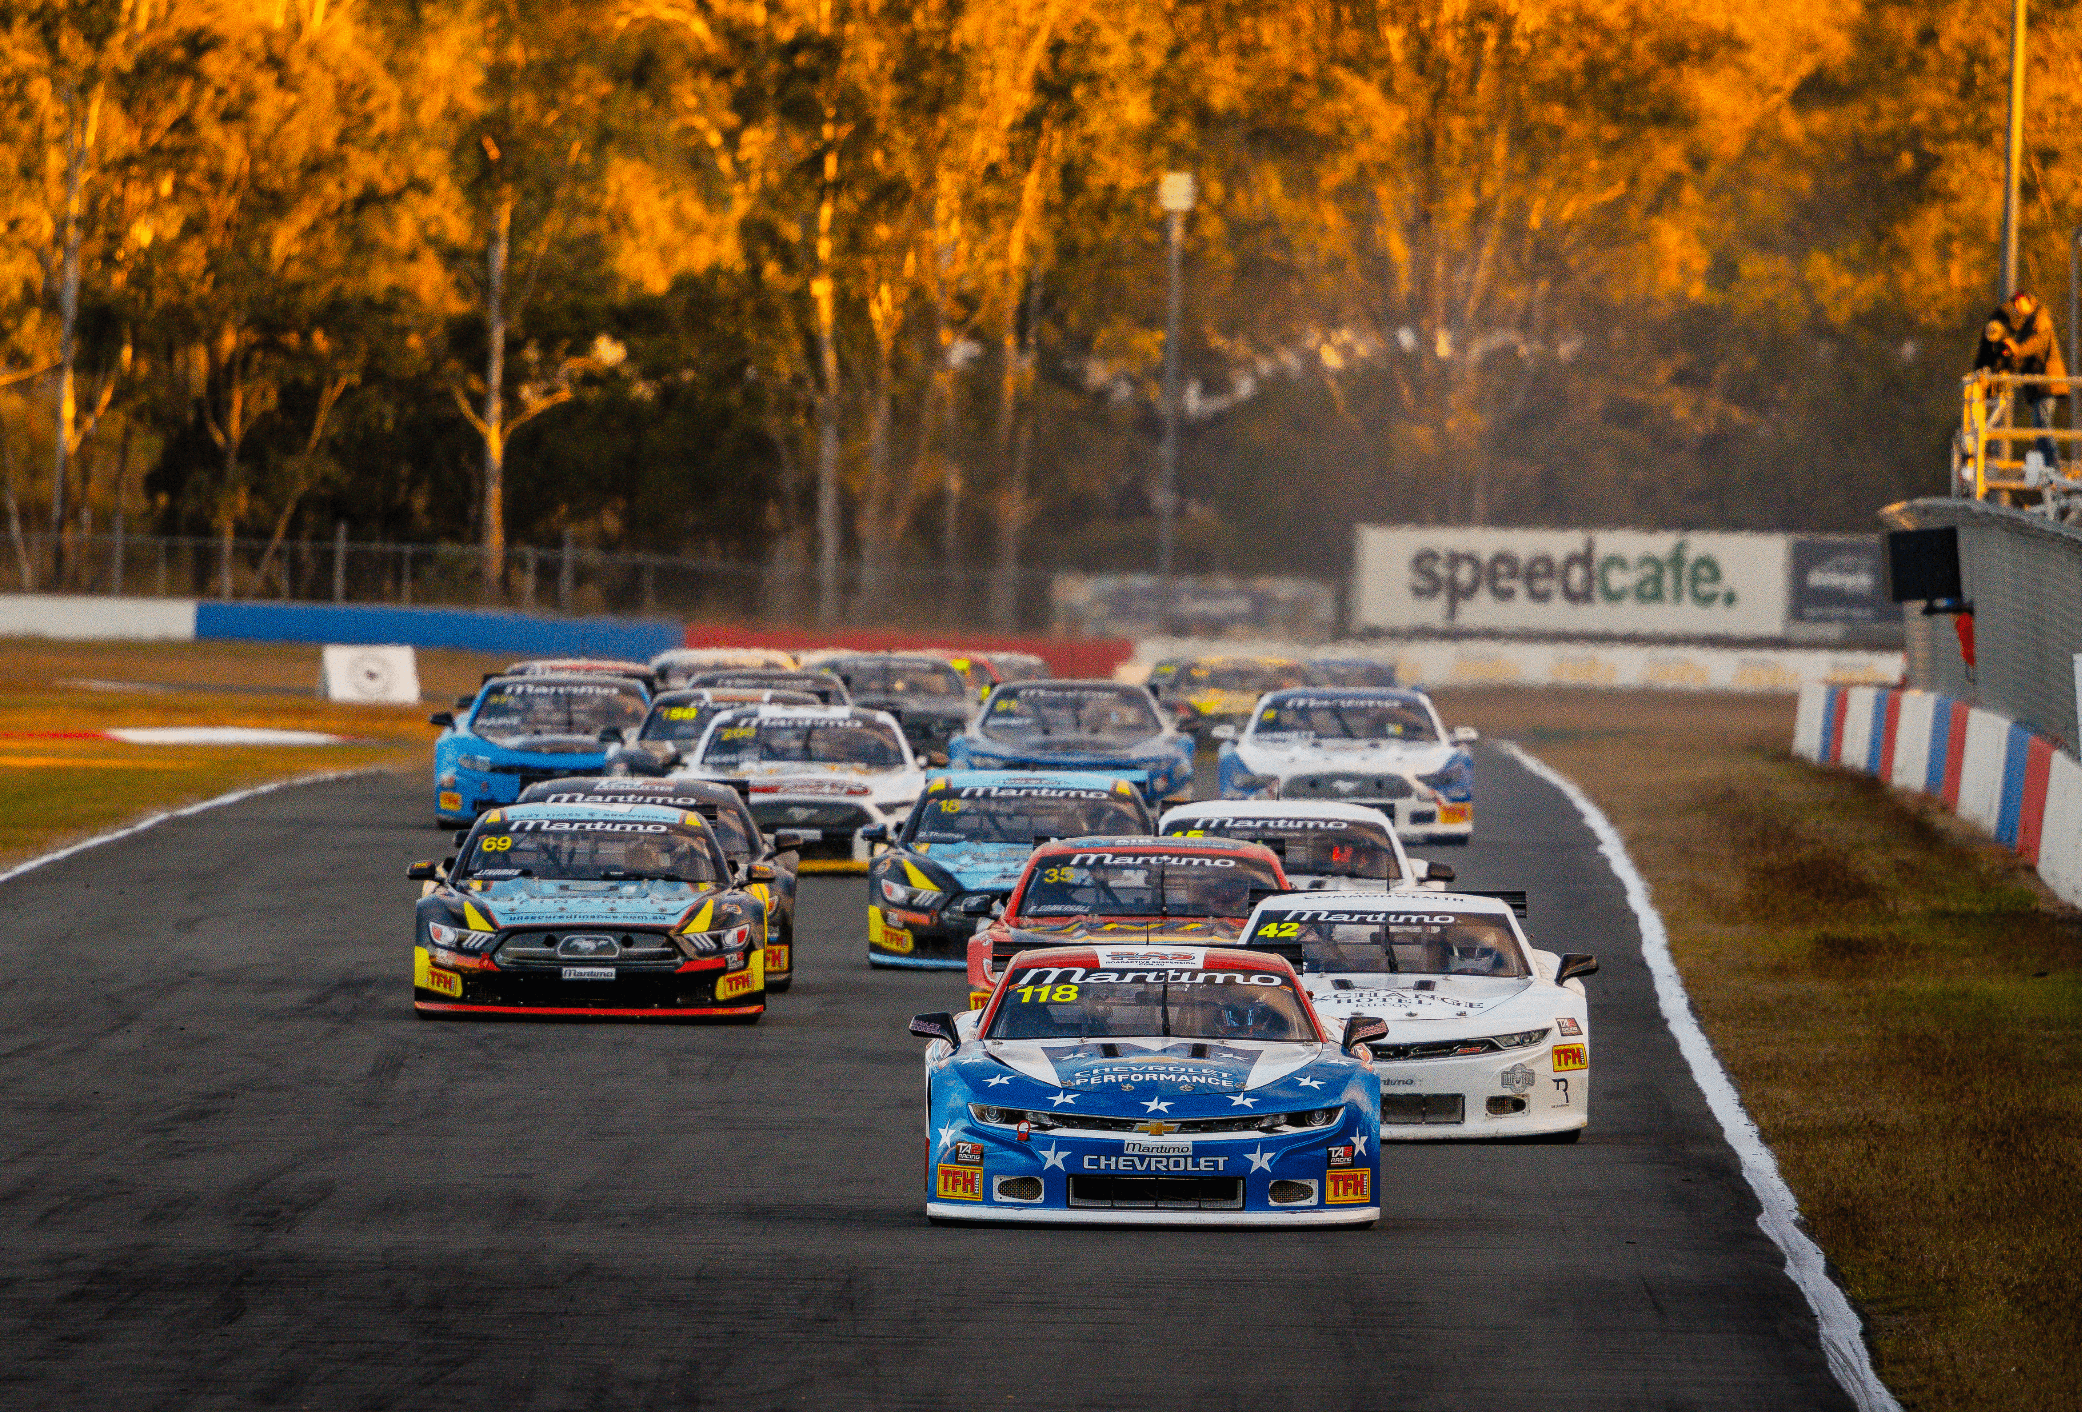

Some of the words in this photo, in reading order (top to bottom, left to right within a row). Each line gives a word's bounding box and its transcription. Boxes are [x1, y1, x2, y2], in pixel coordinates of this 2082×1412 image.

[1409, 537, 1737, 624] speedcafe.
[509, 819, 668, 833] Maritimo
[481, 836, 513, 852] 69
[1069, 853, 1236, 868] Maritimo
[1043, 867, 1075, 883] 35
[1283, 909, 1455, 924] Maritimo
[1257, 922, 1300, 938] 42
[727, 974, 749, 991] TFH
[1018, 967, 1282, 986] Maritimo
[1016, 985, 1079, 1003] 118
[1554, 1047, 1582, 1066] TFH
[1075, 1073, 1235, 1088] PERFORMANCE
[957, 1142, 982, 1155] TA2
[1125, 1141, 1190, 1154] Maritimo
[1328, 1145, 1353, 1158] TA2
[1083, 1155, 1230, 1171] CHEVROLET
[940, 1168, 975, 1193] TFH
[1330, 1173, 1365, 1196] TFH
